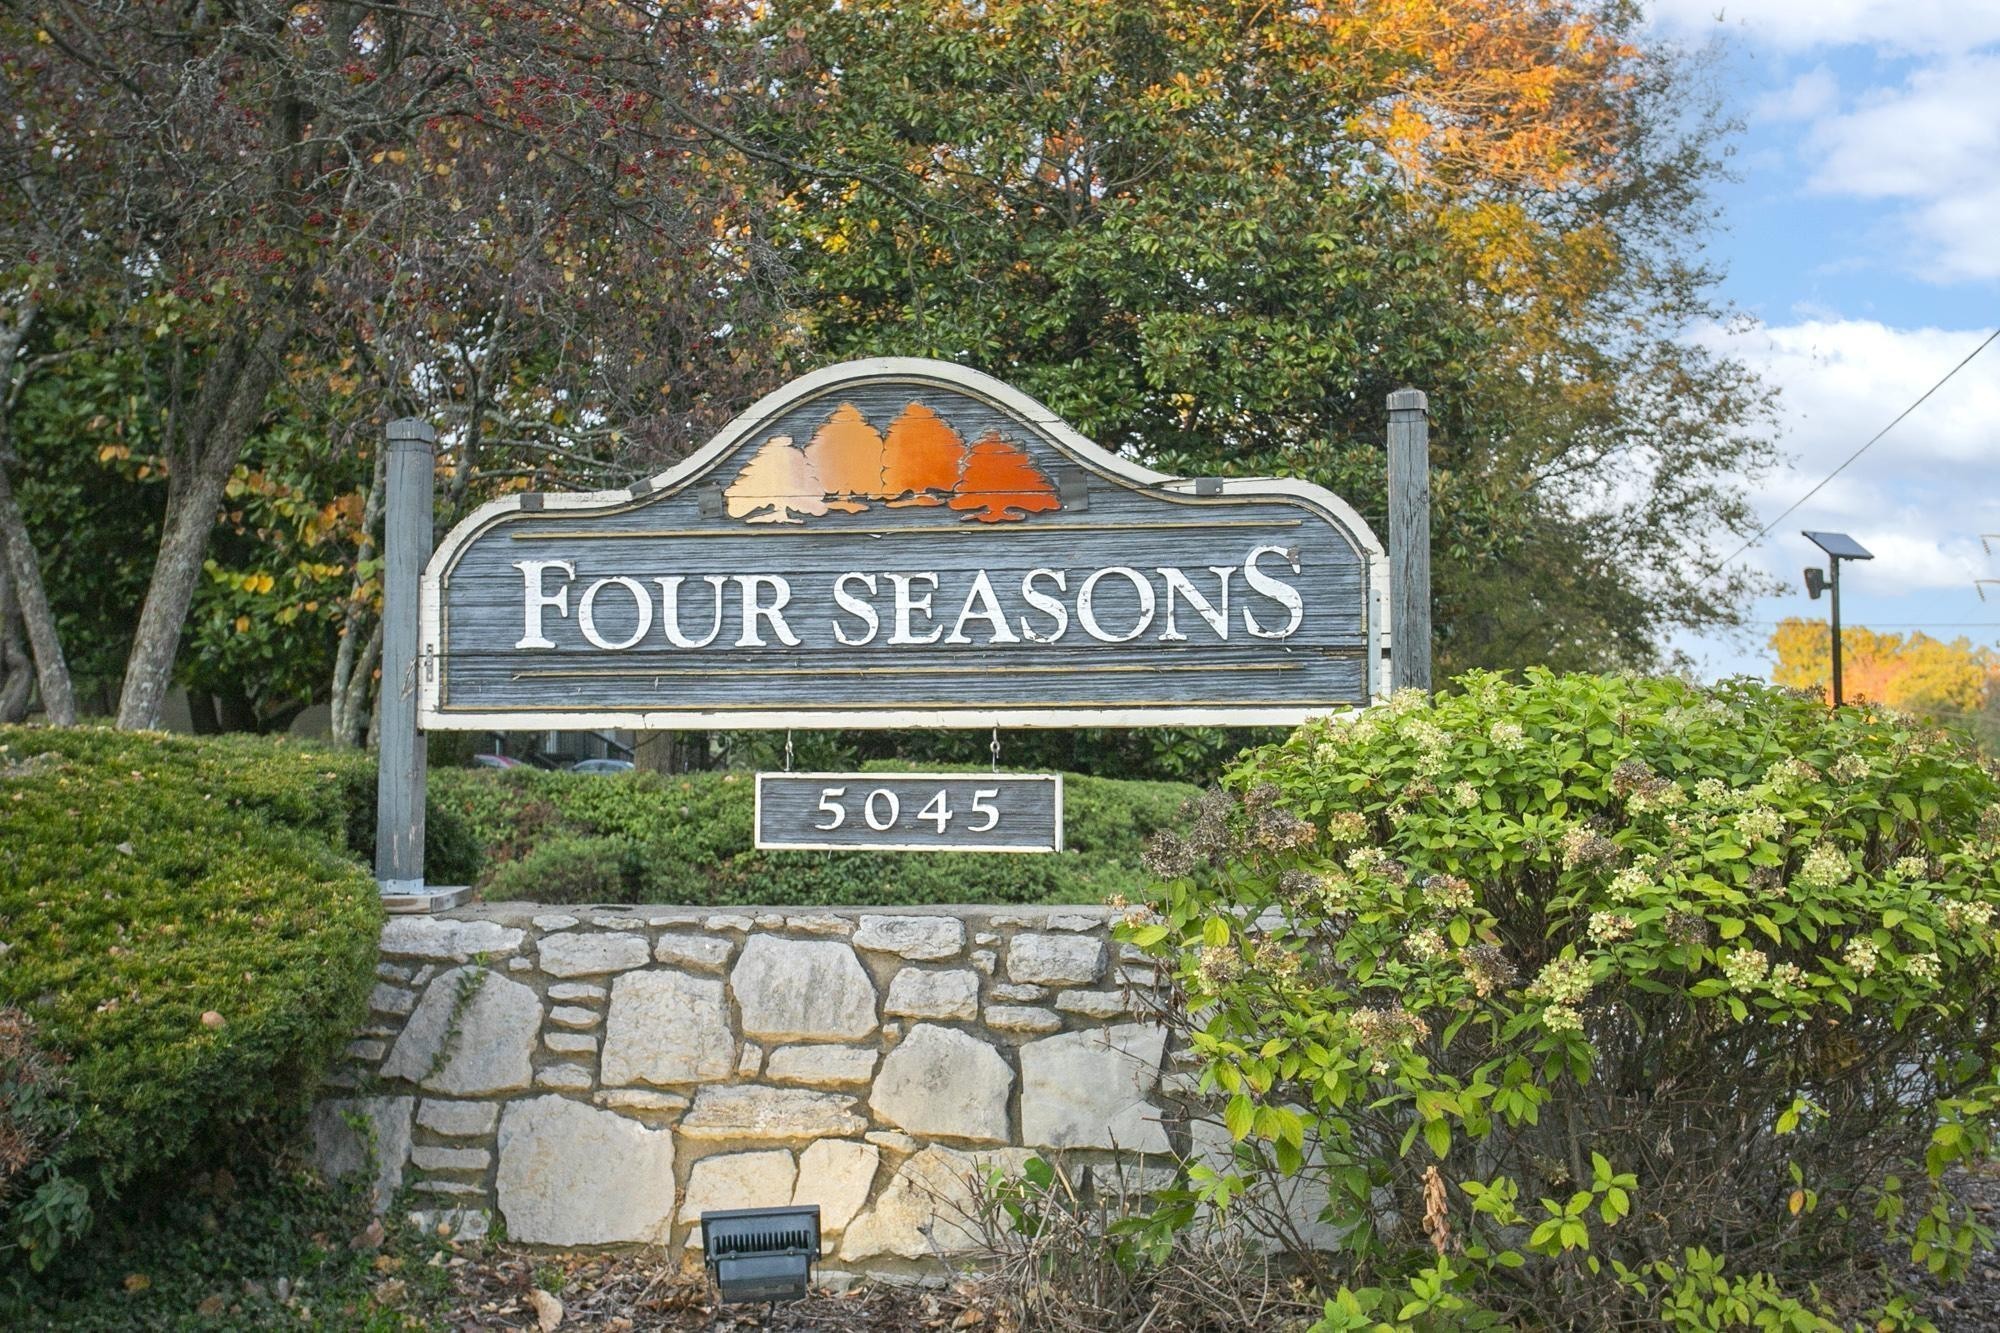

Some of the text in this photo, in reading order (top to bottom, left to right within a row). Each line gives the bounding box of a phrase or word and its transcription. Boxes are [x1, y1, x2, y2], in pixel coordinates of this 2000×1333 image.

[513, 545, 1304, 650] FOUR SEASONS
[815, 786, 1001, 834] 5045
